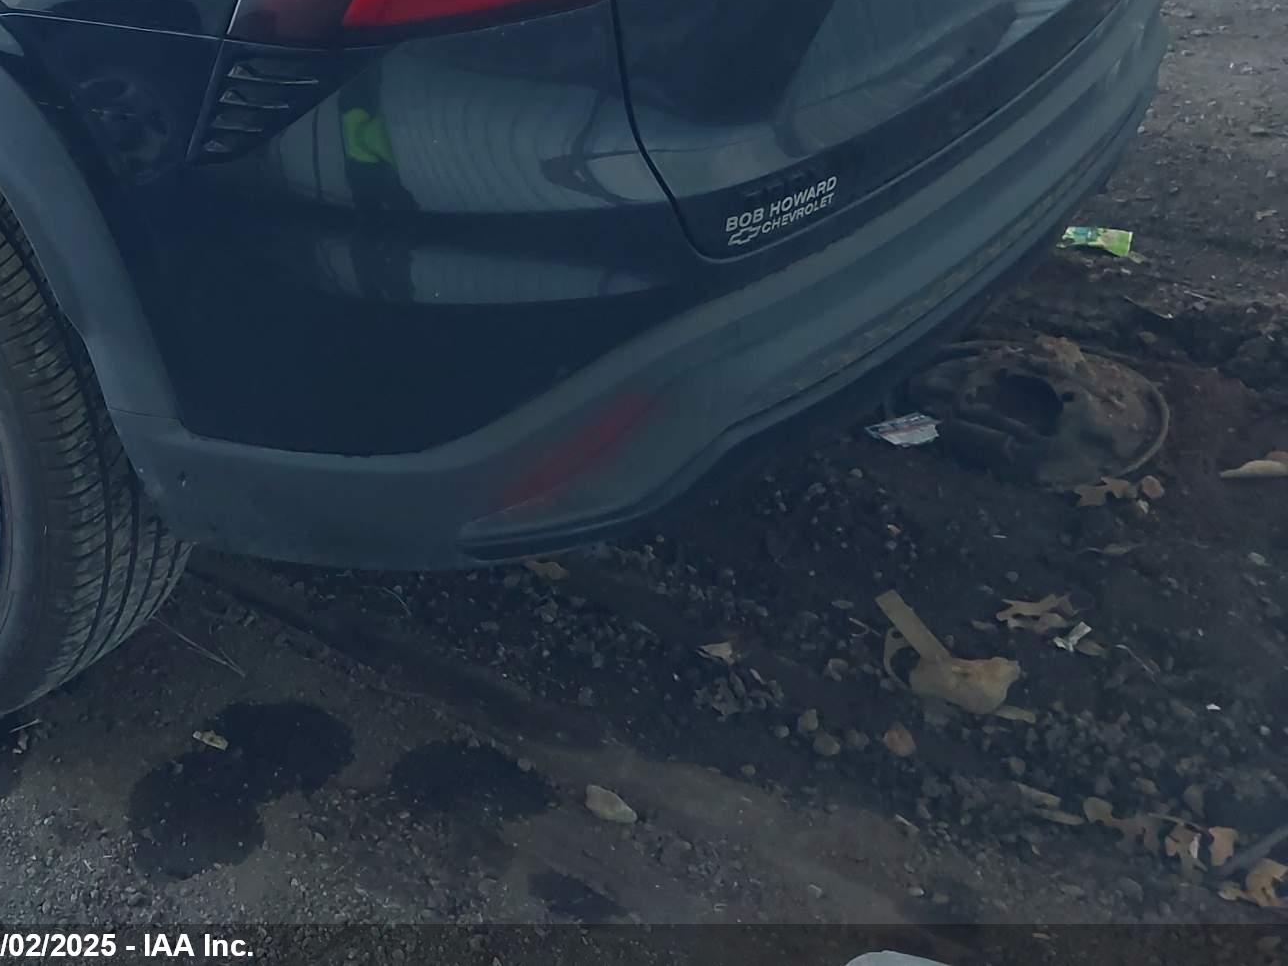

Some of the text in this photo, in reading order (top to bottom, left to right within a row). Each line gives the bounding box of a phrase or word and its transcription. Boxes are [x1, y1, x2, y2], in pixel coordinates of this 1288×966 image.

[725, 175, 838, 233] BOB HOWARD
[761, 192, 835, 234] CHEVROLET
